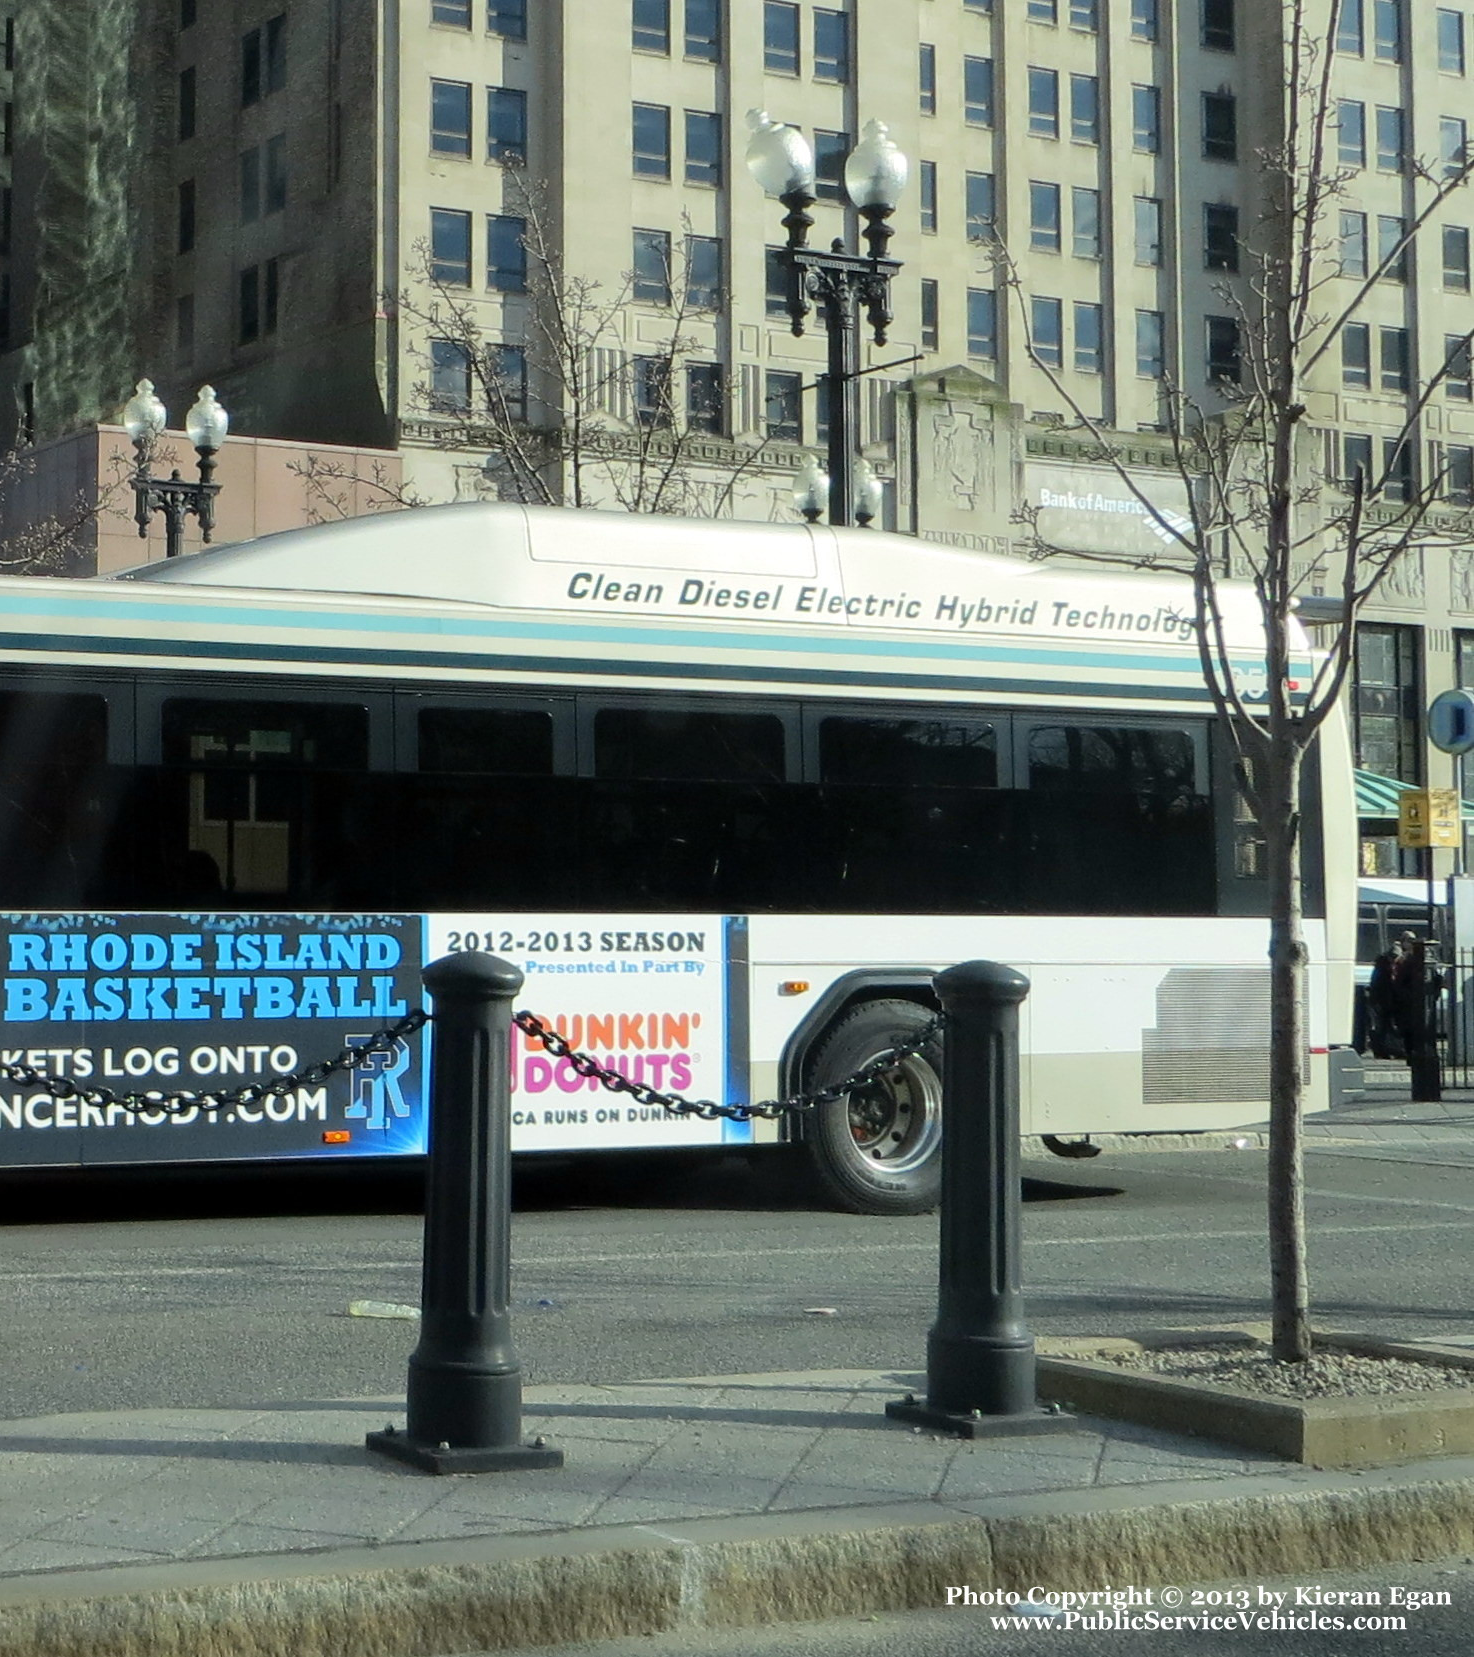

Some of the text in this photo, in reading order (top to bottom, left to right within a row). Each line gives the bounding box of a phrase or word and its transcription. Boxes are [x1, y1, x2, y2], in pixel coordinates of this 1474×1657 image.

[1040, 488, 1077, 509] Bank
[1078, 492, 1093, 510] of
[567, 572, 1213, 641] Clean Diesel Electric Hybrid Technolog
[8, 933, 202, 971] RHODE
[215, 933, 402, 970] ISLAND
[447, 931, 593, 952] 2012-2013
[600, 931, 706, 952] SEASON
[526, 960, 616, 974] Presented
[621, 960, 638, 973] In
[642, 960, 677, 974] Part
[683, 961, 705, 976] By
[3, 976, 407, 1022] BASKETBALL
[104, 1046, 179, 1077] LOG
[190, 1045, 298, 1075] ONTO
[524, 1053, 692, 1094] DONUTS
[544, 1110, 588, 1125] RUNS
[595, 1109, 620, 1123] ON
